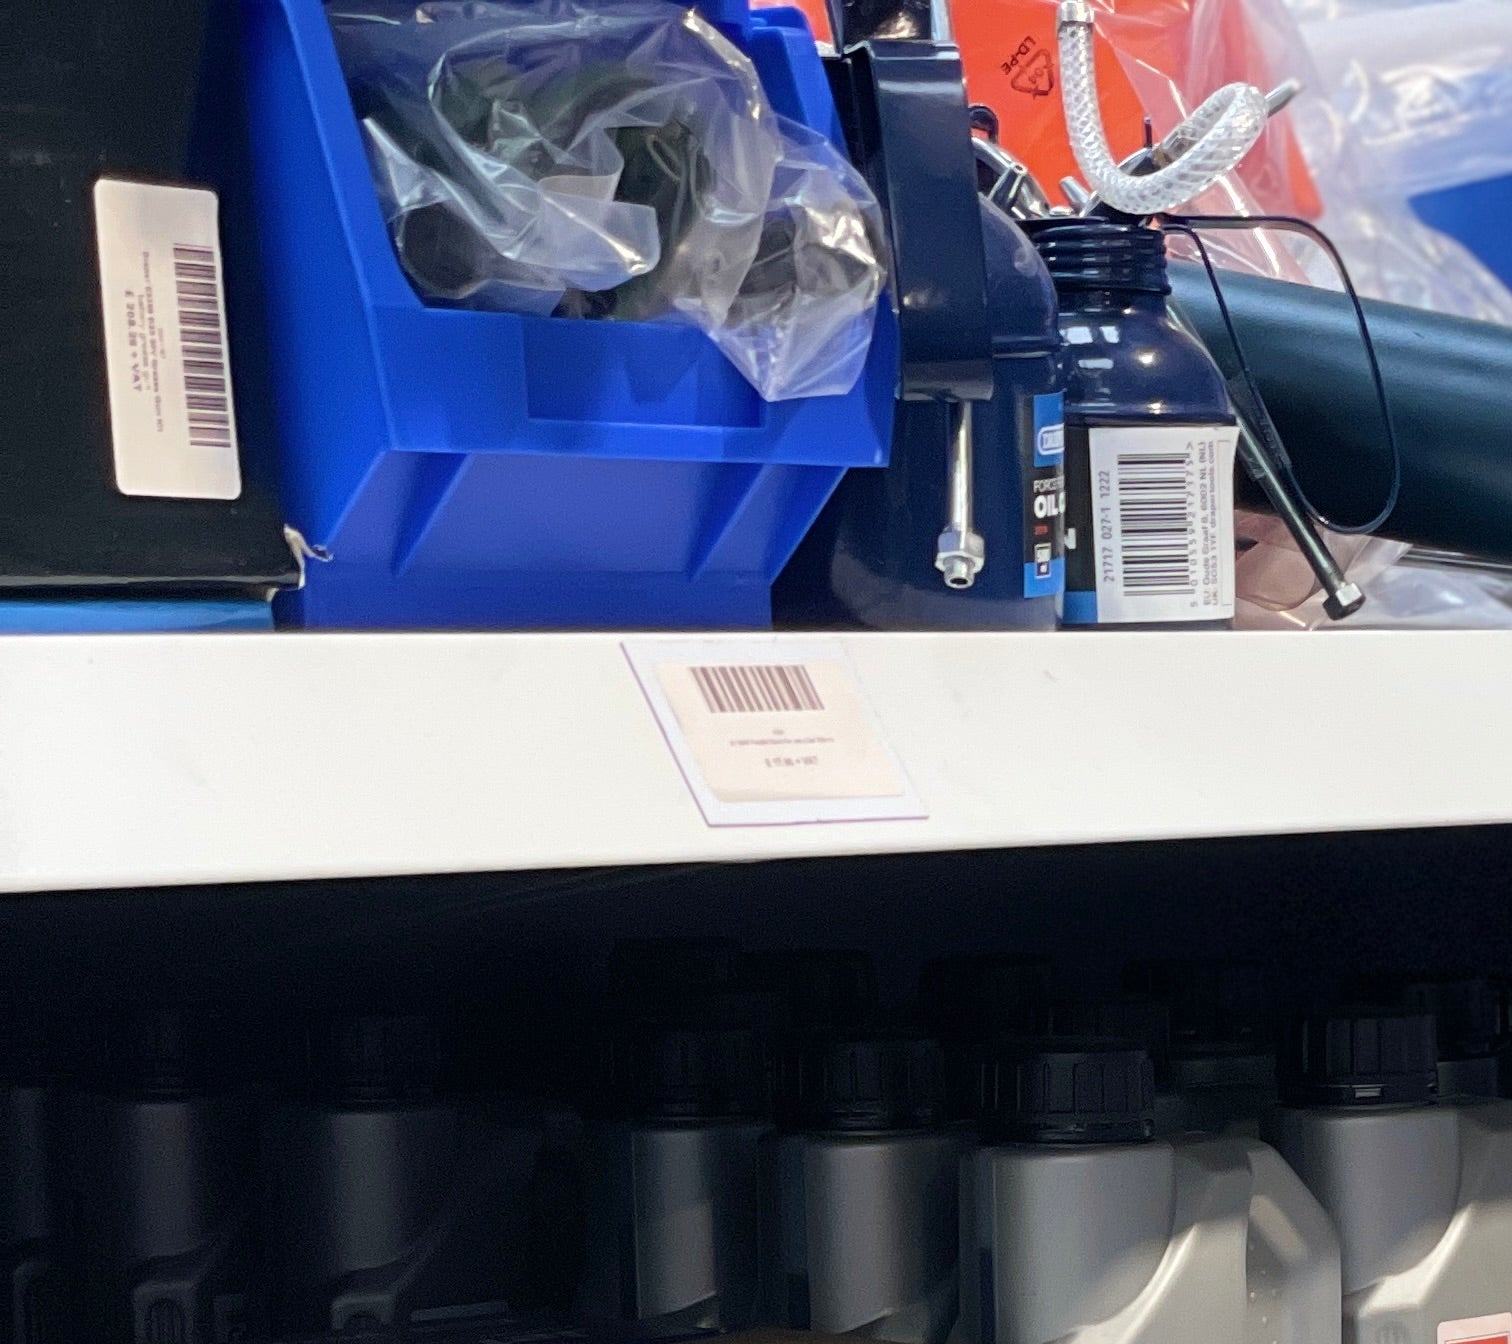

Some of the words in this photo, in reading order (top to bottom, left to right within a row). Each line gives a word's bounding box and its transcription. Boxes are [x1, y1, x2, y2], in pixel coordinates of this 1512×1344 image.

[131, 363, 142, 392] VAT
[1098, 470, 1111, 499] 1222
[1100, 507, 1112, 541] 027-1
[1102, 546, 1115, 583] 21717
